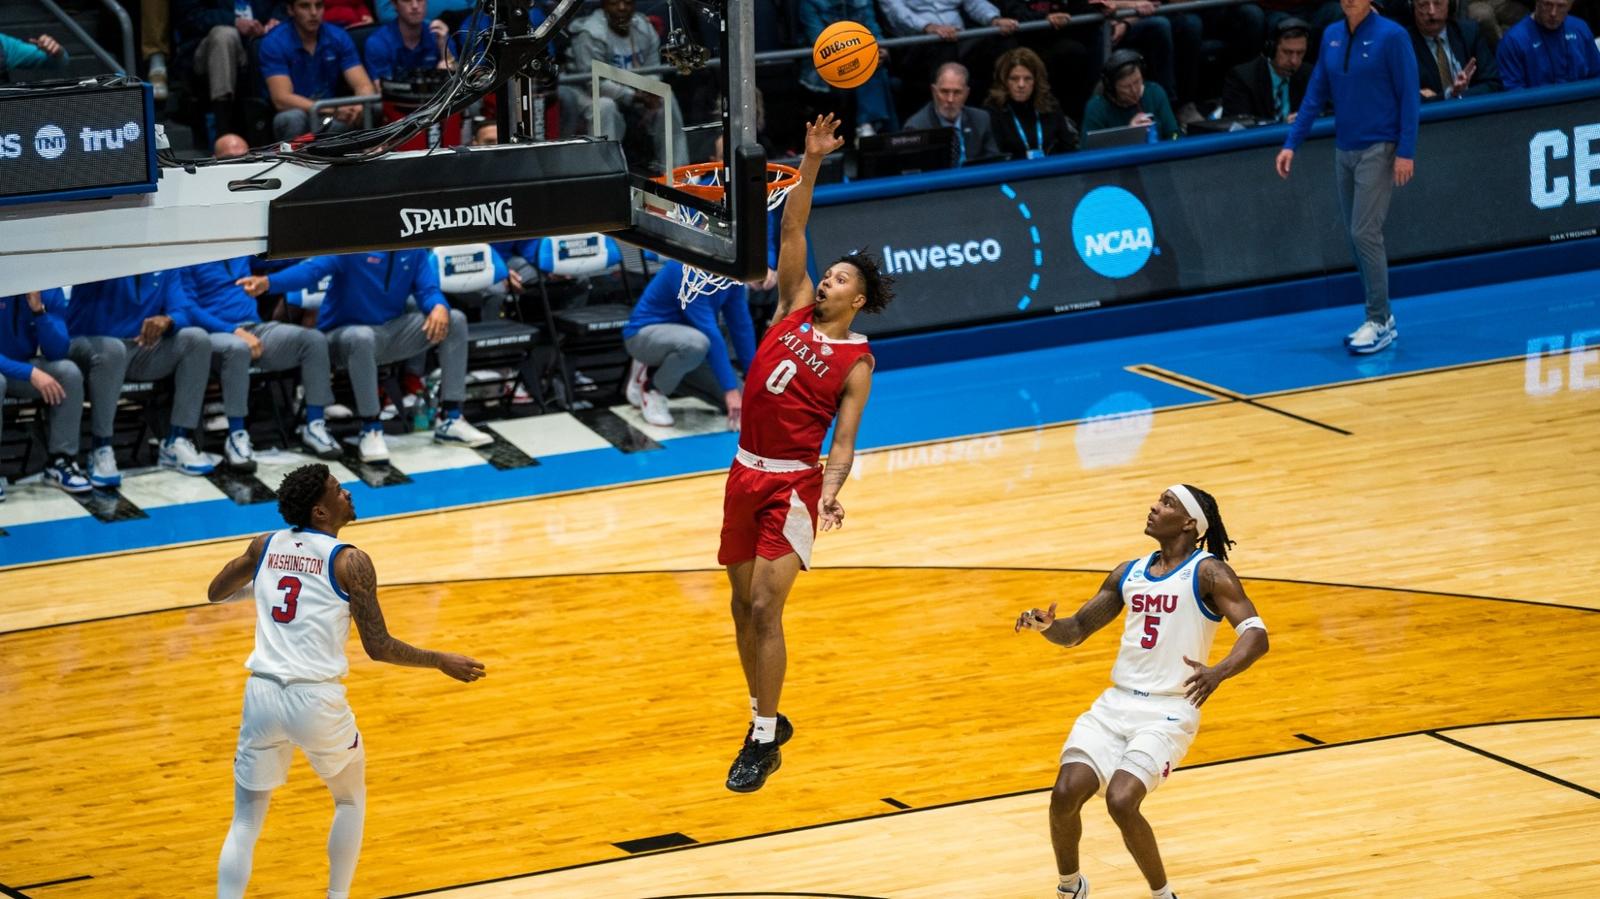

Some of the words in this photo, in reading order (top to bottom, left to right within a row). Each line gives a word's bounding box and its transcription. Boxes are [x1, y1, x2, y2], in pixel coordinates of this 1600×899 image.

[819, 37, 861, 60] Wilson
[1529, 123, 1600, 209] CE
[400, 197, 513, 237] SPALDING
[1084, 227, 1153, 257] NCAA
[1549, 229, 1597, 241] DAKTRONICS
[883, 238, 1001, 274] Invesco
[1054, 300, 1101, 312] DAKTRONICS
[778, 331, 830, 378] MIAMI
[766, 359, 798, 395] 0
[267, 554, 324, 575] WASHINGTON
[271, 575, 302, 624] 3
[1131, 594, 1179, 614] SMU
[1140, 614, 1161, 650] 5
[1133, 689, 1150, 698] SMU
